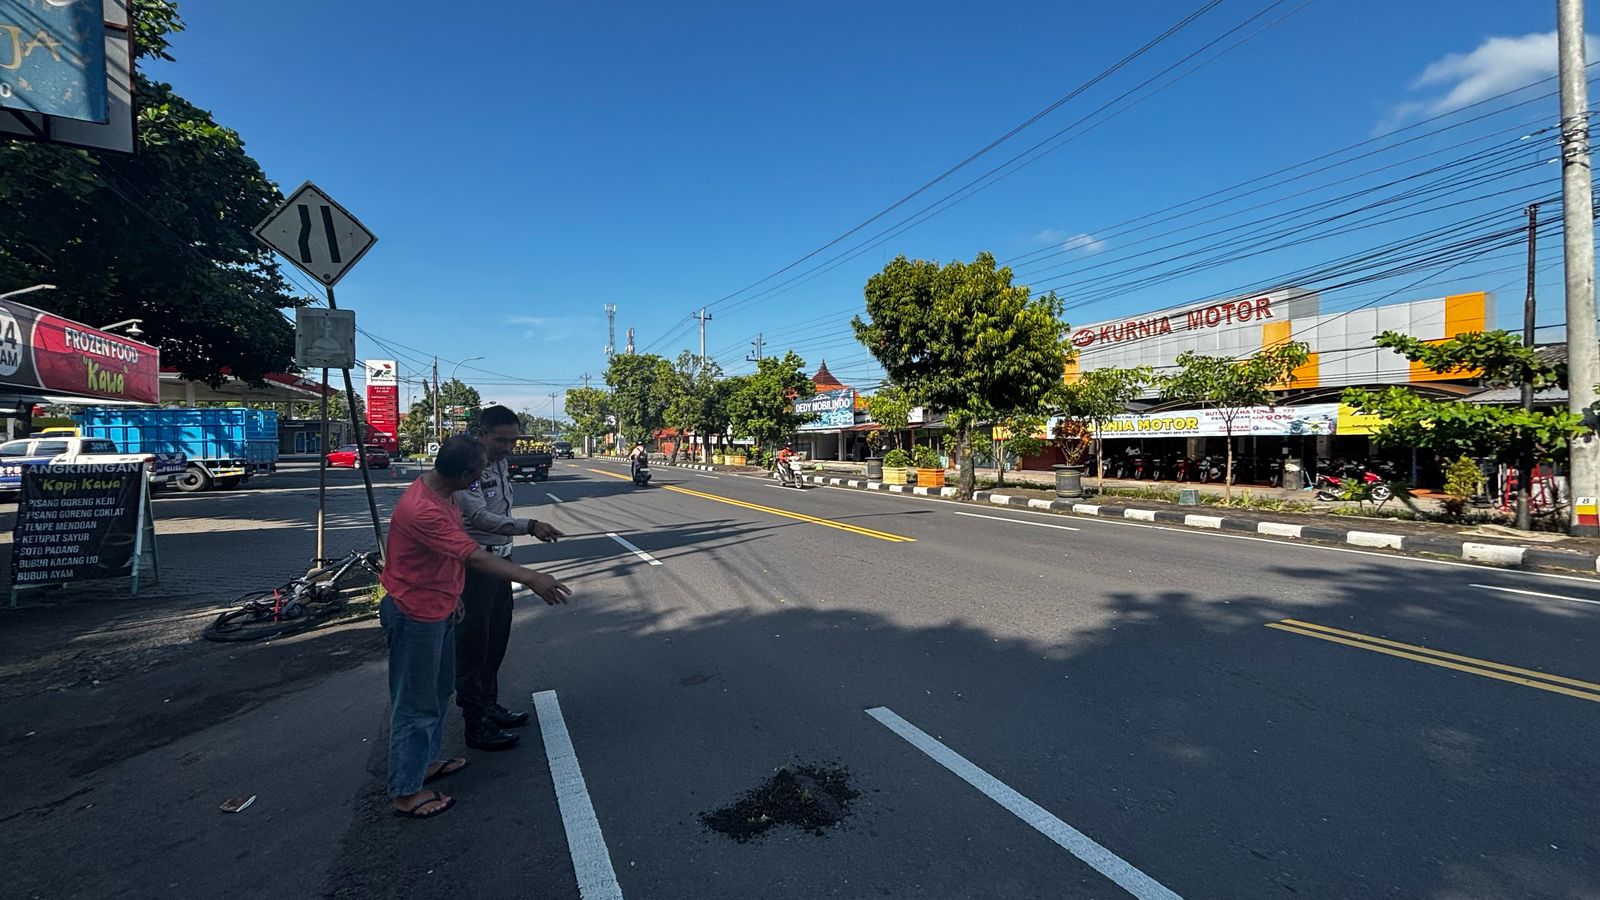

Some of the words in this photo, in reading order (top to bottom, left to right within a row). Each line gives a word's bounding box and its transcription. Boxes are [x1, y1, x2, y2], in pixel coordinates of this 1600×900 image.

[1099, 316, 1173, 344] KURNIA
[1186, 297, 1273, 331] MOTOR
[0, 320, 17, 350] 4
[65, 327, 110, 357] FROZEN
[111, 342, 138, 364] FOOD
[795, 401, 811, 412] DEDY
[1138, 417, 1199, 430] MOTOR
[27, 463, 139, 474] ANGKRINGAN
[27, 498, 59, 508] PISANG
[60, 497, 94, 507] GORENG
[95, 496, 116, 505] KEJU
[26, 510, 58, 520] PISANG
[59, 509, 93, 518] GORENG
[93, 507, 125, 517] COKLAT
[25, 522, 54, 532] TEMPE
[55, 521, 97, 531] MENDOAN
[22, 534, 61, 544] KETUPAT
[62, 532, 90, 542] SAYUR
[20, 546, 43, 556] SOTO
[44, 545, 80, 555] PADANG
[18, 558, 49, 568] BUBUR
[50, 556, 85, 567] KACANG
[86, 555, 99, 564] IJO
[16, 571, 48, 580] BUBUR
[50, 569, 74, 579] AYAM
